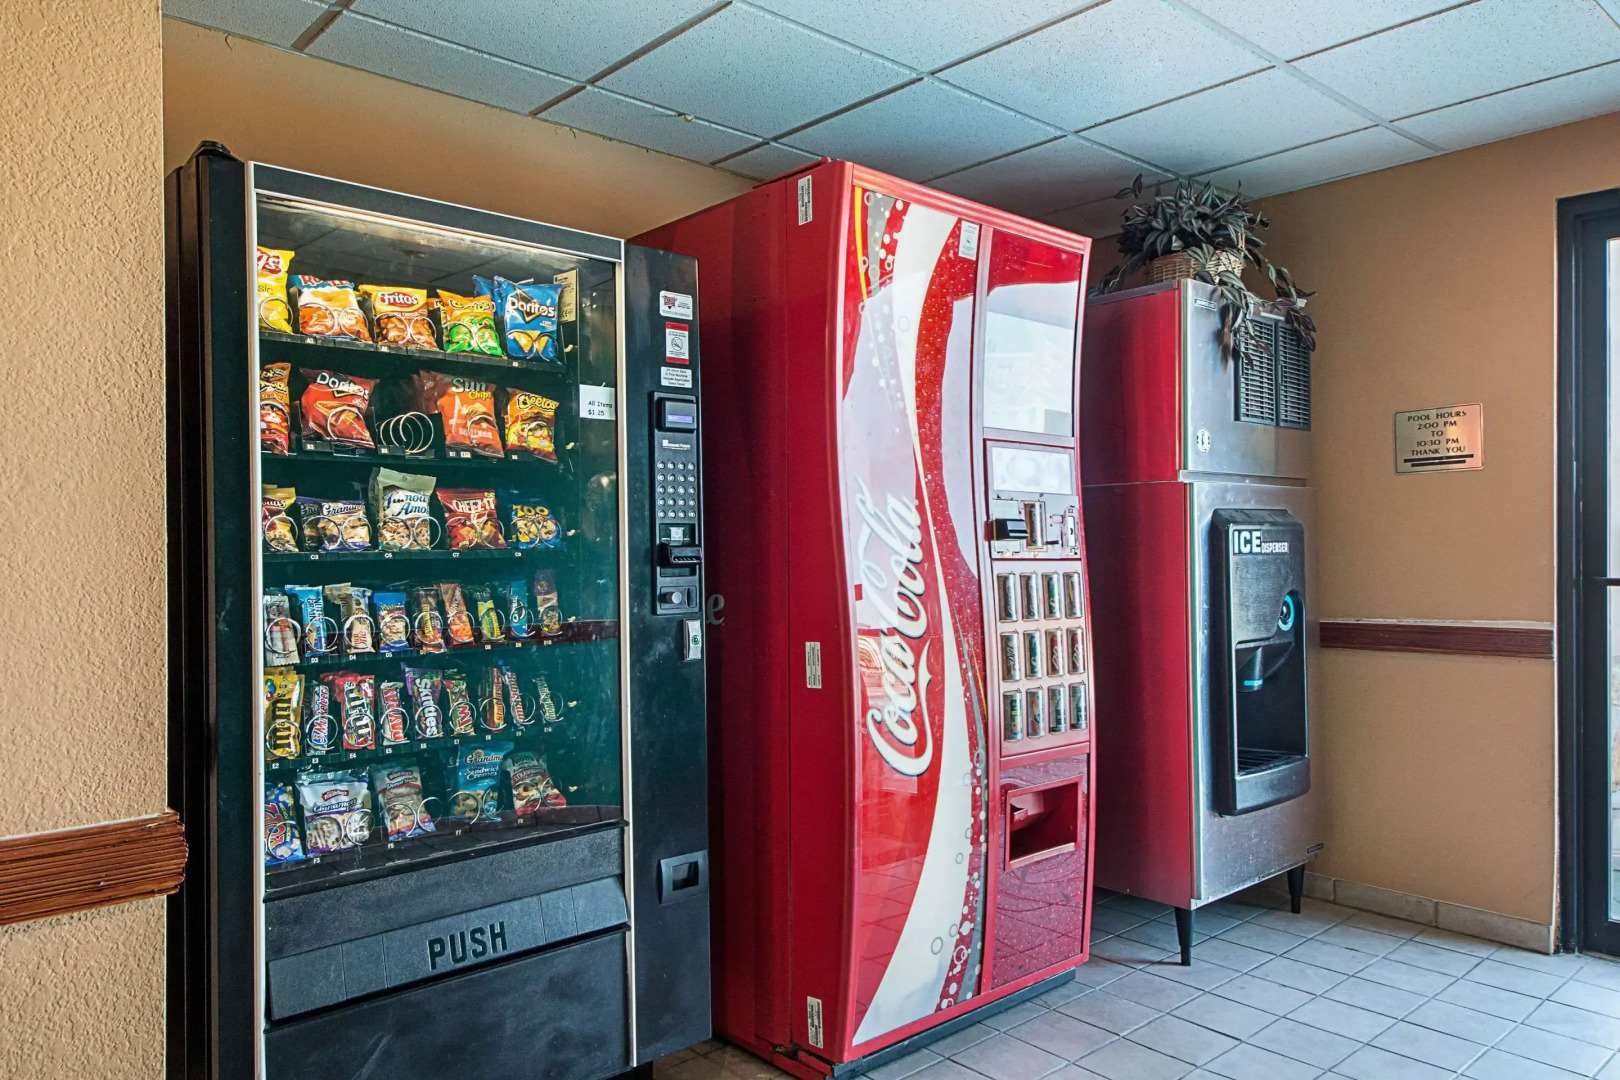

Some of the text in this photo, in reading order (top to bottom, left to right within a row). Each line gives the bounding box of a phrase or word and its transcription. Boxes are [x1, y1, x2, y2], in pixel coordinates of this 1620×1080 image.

[378, 292, 418, 306] Fritos
[507, 296, 555, 318] Doritos
[452, 378, 486, 395] Sun
[1407, 411, 1467, 422] POOL HOURS
[1418, 422, 1438, 430] 2:00
[1417, 440, 1441, 448] 10:30
[1411, 448, 1440, 456] THANK
[1233, 530, 1262, 554] ICE
[1262, 541, 1289, 554] DISPENSER
[857, 472, 936, 778] Coca-Cola
[427, 921, 507, 971] PUSH
